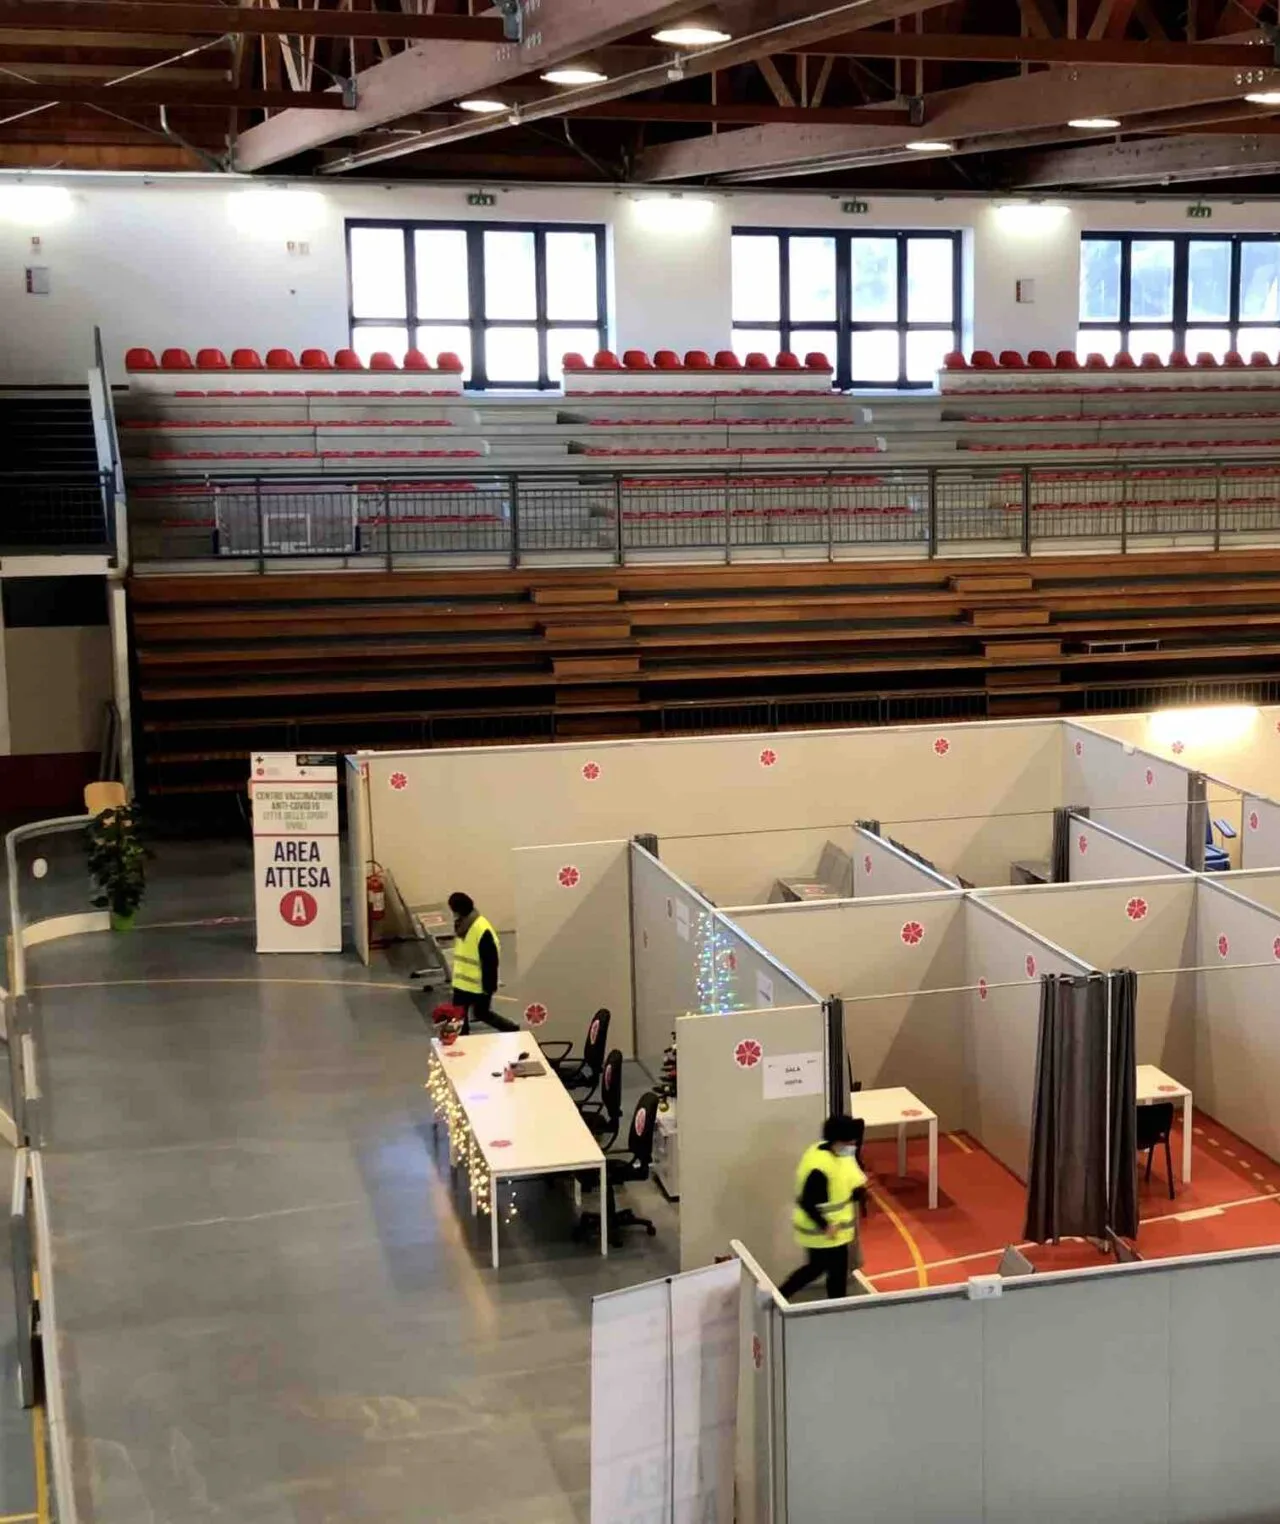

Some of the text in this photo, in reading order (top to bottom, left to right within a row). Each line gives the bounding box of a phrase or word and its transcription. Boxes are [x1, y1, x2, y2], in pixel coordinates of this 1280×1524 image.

[274, 841, 320, 862] AREA
[265, 866, 331, 888] ATTESA
[291, 895, 307, 921] A
